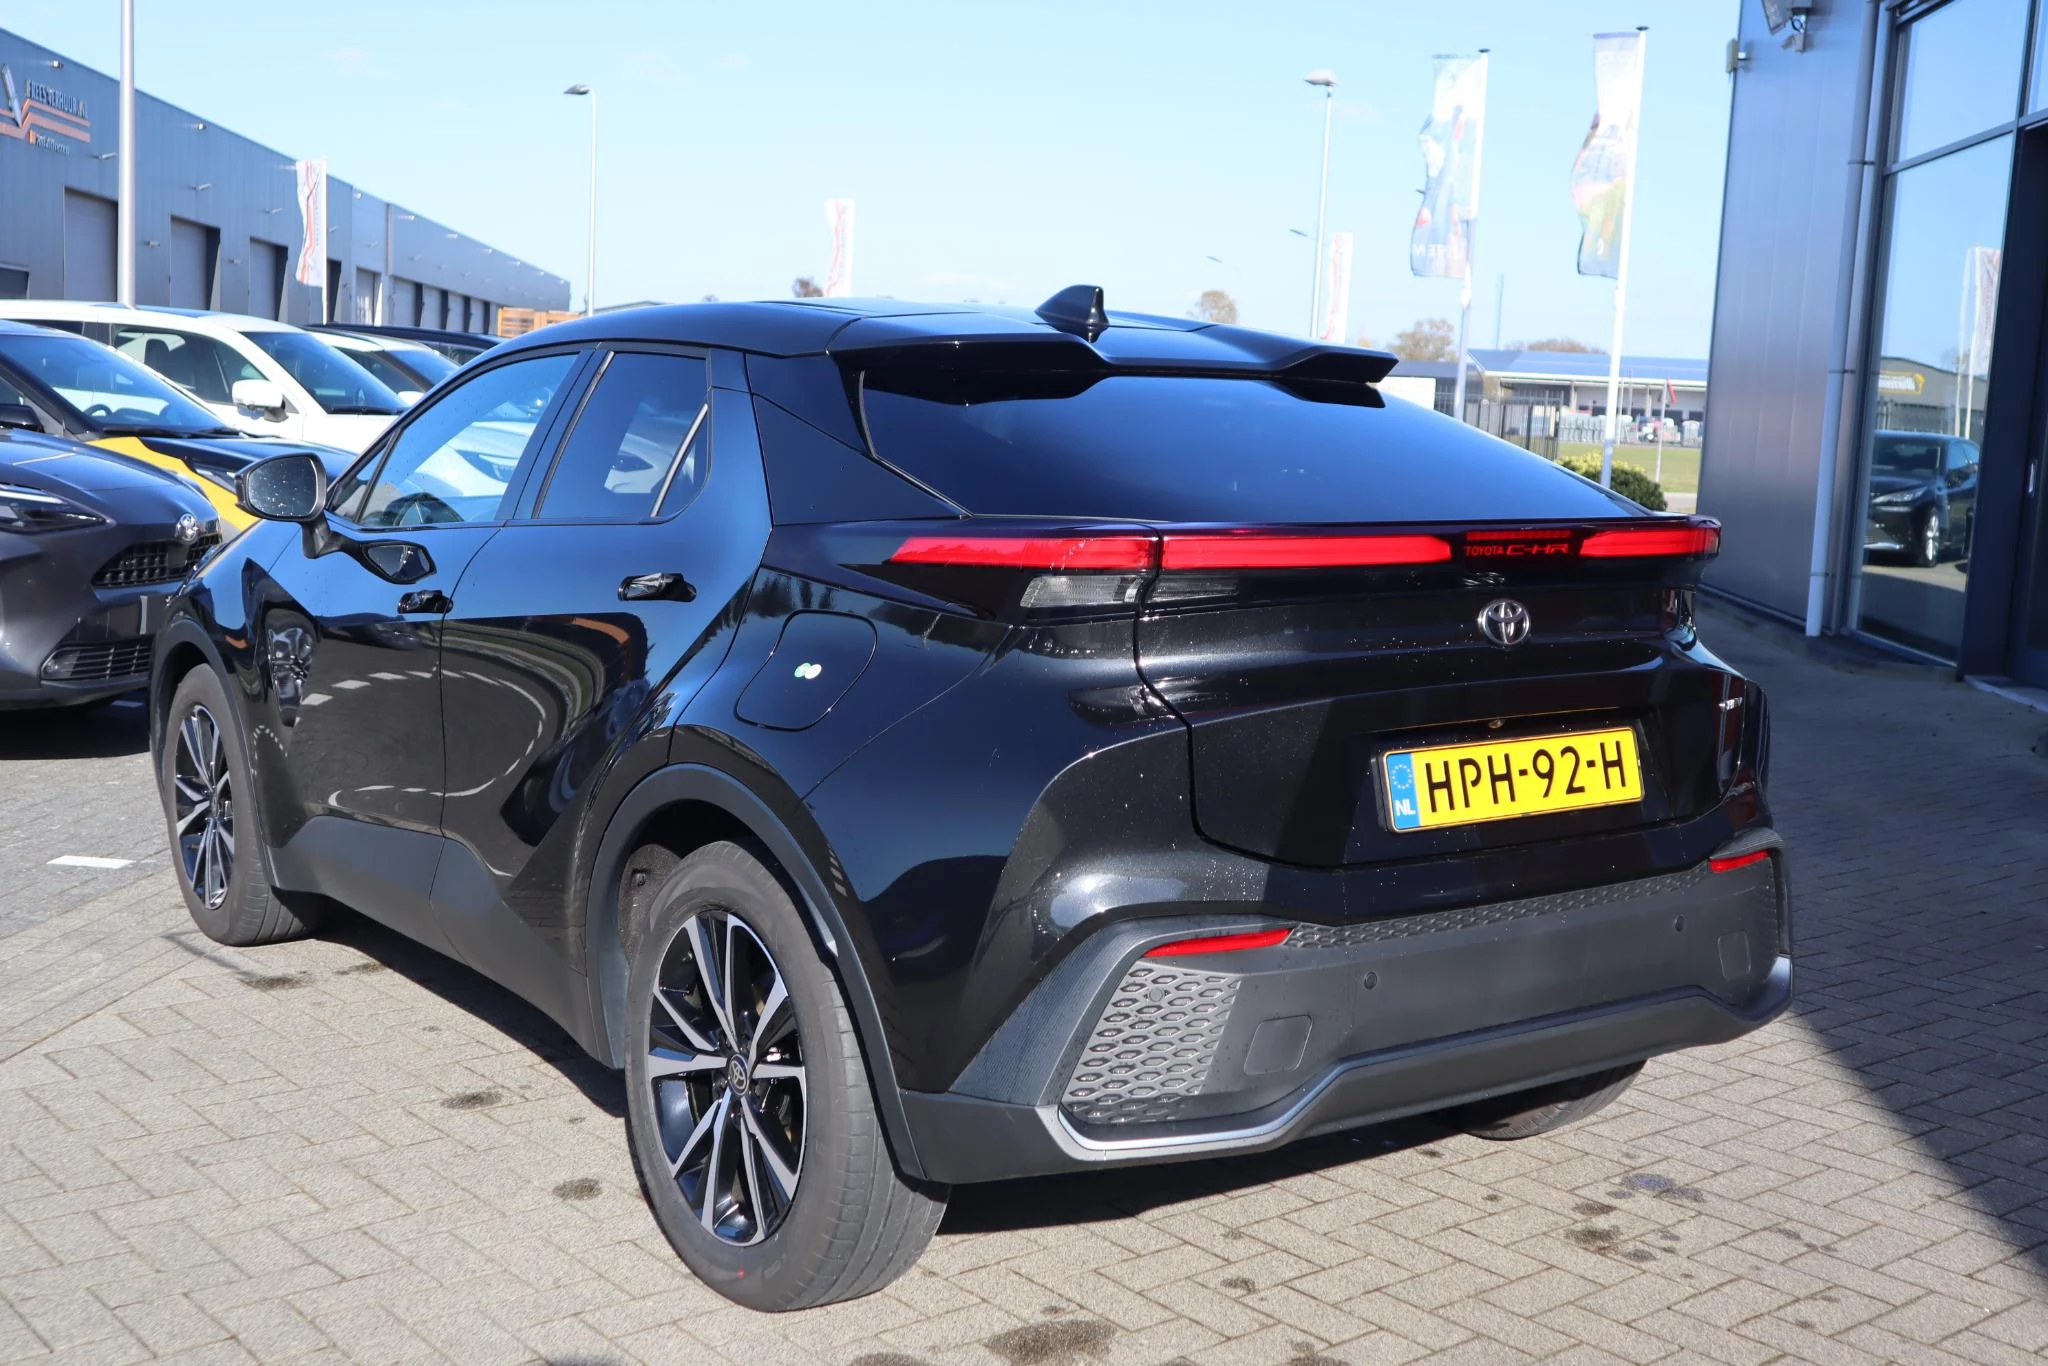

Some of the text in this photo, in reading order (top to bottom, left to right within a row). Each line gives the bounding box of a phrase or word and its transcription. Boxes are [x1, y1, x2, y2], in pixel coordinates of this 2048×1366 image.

[1465, 543, 1569, 556] TOYOTA C-HR
[1425, 740, 1626, 813] HPH-92-H
[1395, 799, 1416, 816] NL
